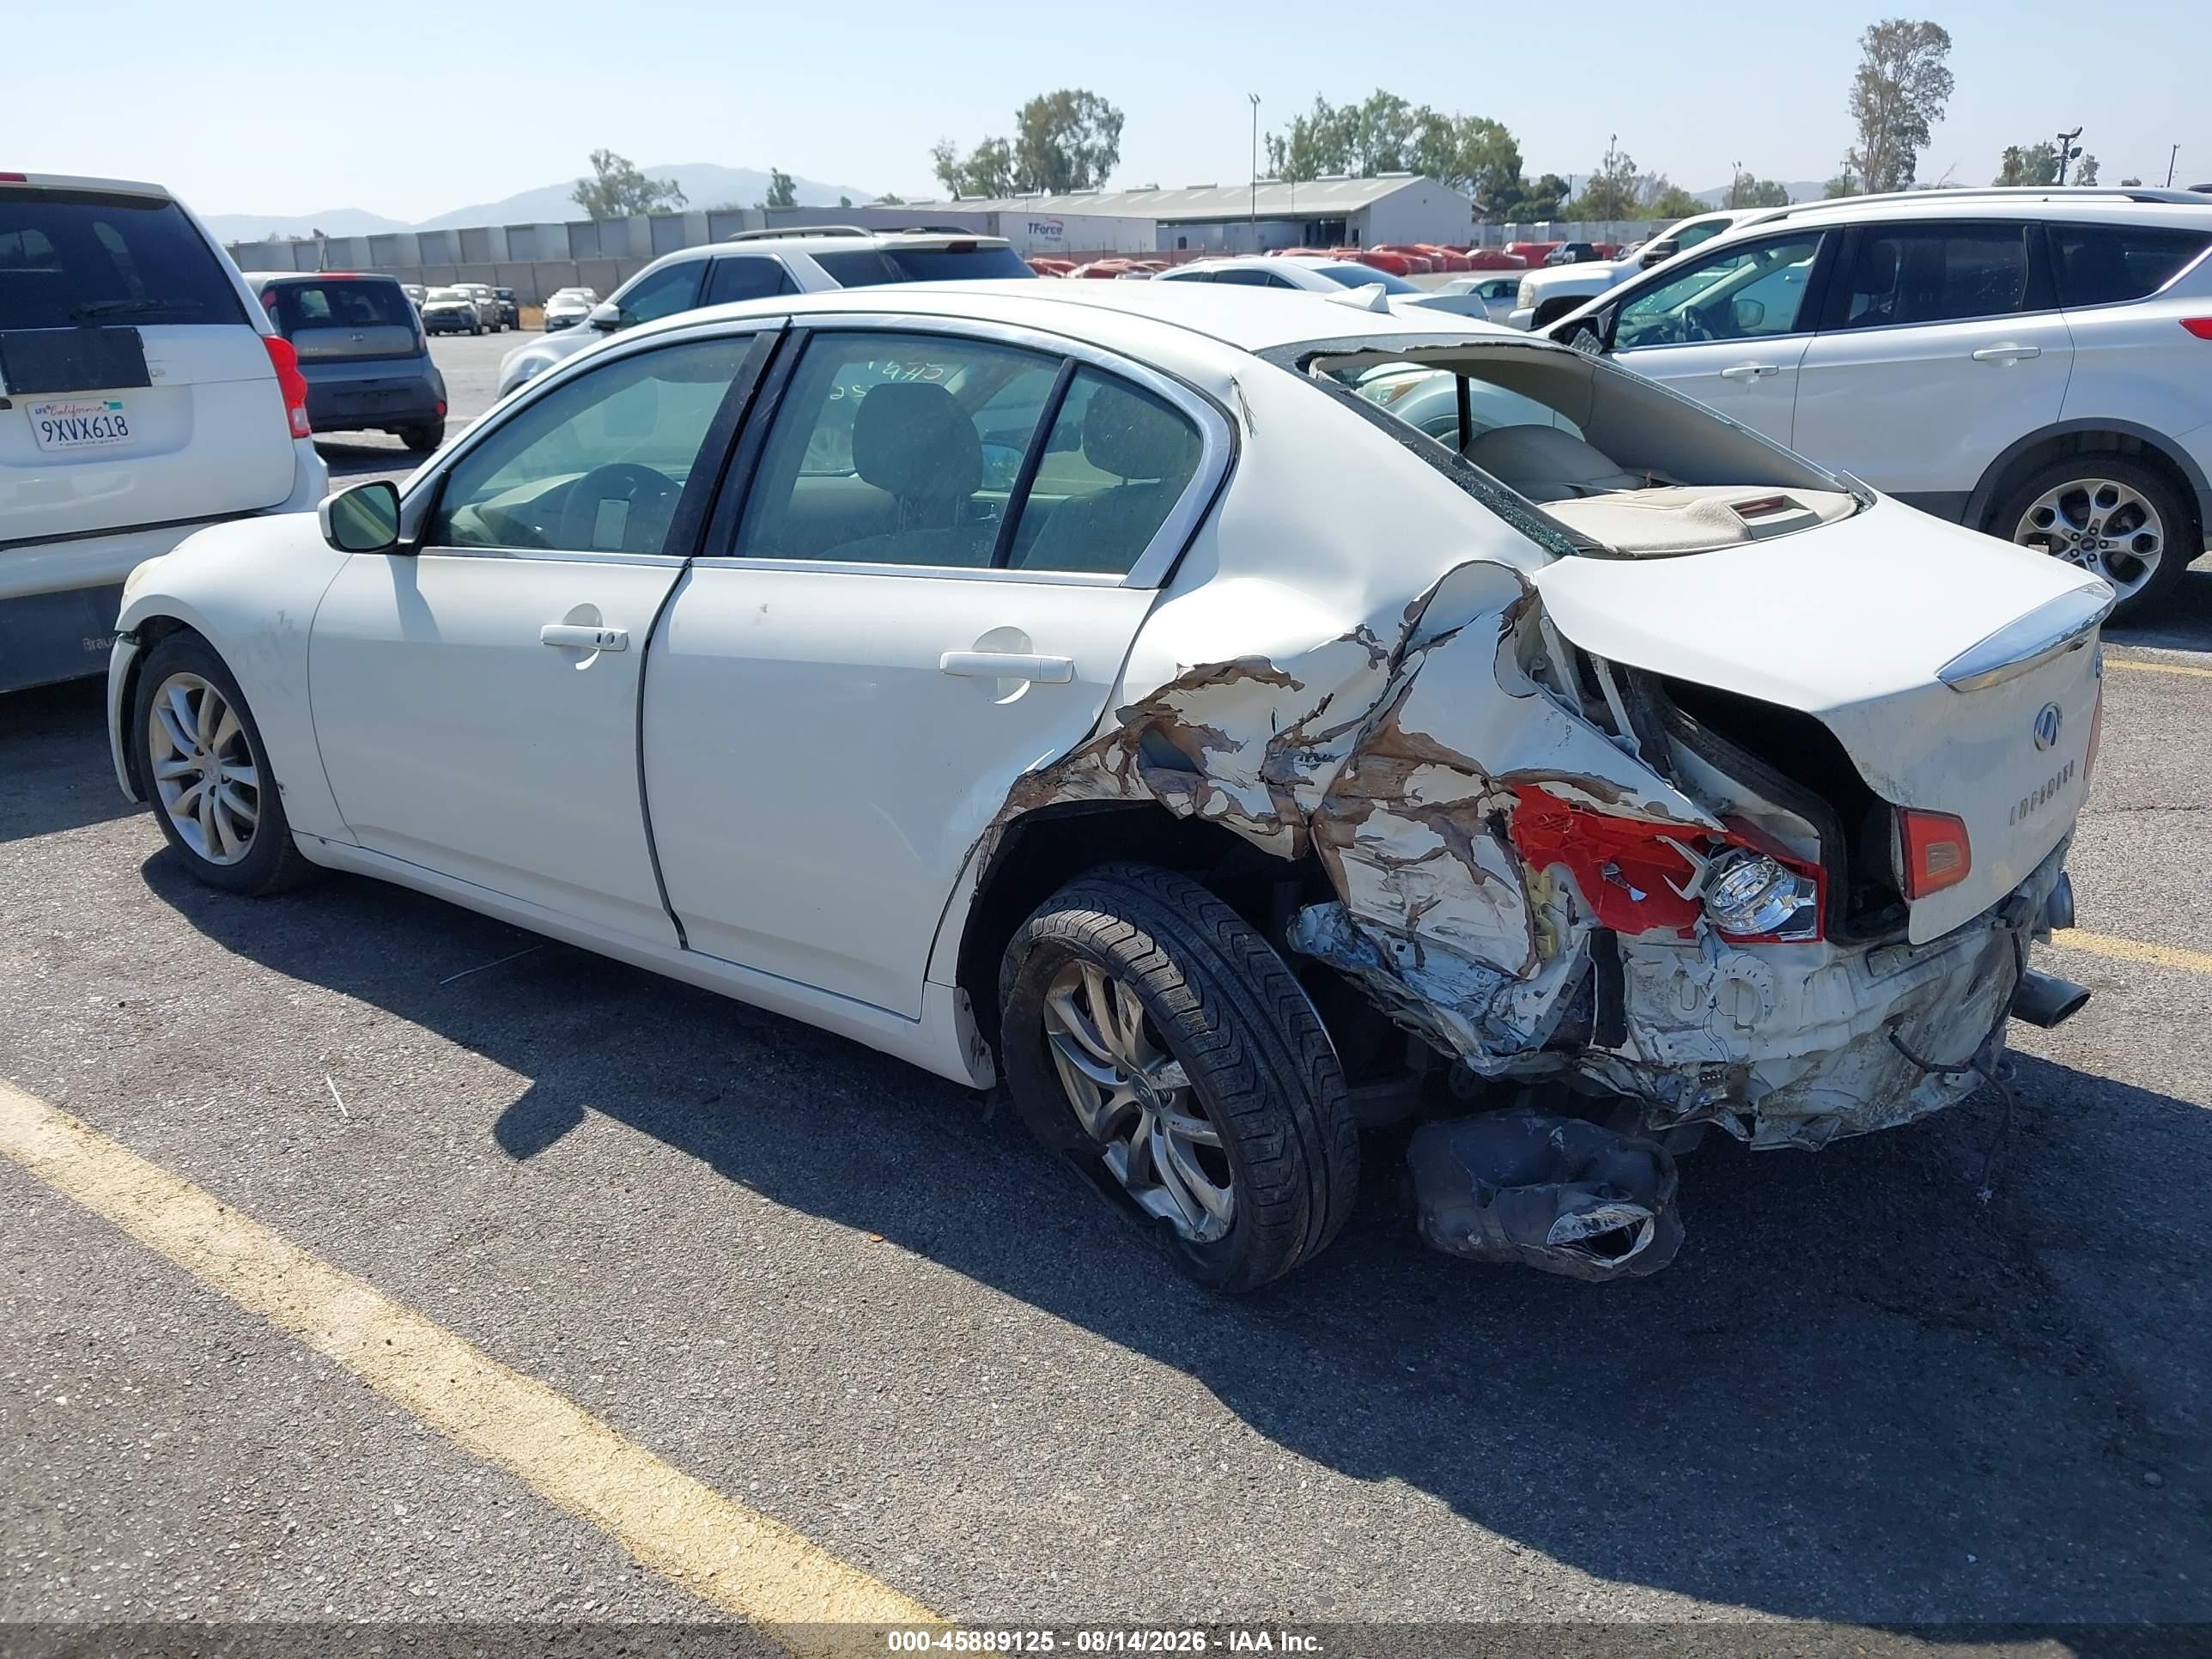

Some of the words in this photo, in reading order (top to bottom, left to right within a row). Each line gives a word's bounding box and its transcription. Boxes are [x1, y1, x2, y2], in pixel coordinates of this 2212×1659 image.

[1028, 222, 1062, 234] TForce
[50, 404, 104, 417] California
[40, 416, 129, 442] 9XVX618
[2009, 759, 2075, 826] INFINITI
